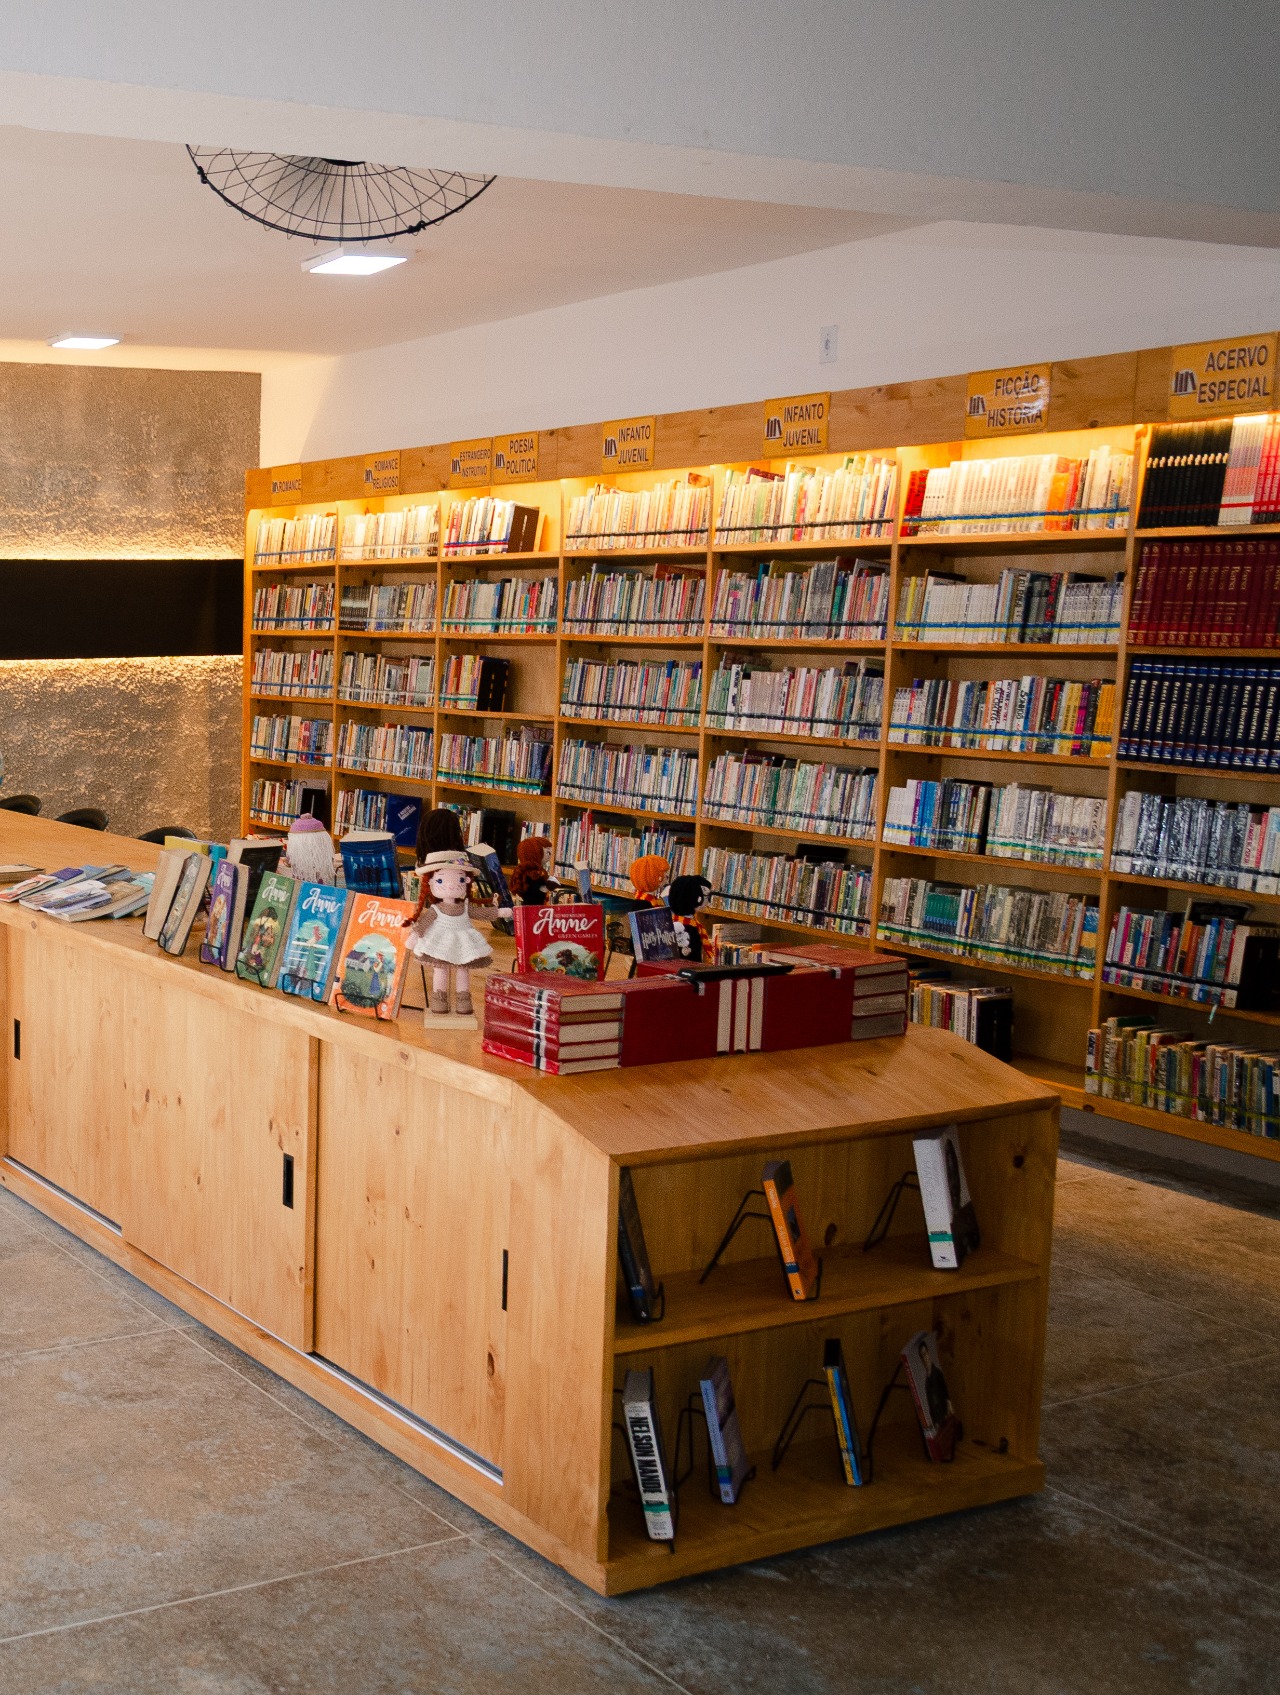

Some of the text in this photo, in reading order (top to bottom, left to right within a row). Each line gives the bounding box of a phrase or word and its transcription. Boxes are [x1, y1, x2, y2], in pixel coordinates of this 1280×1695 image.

[1204, 344, 1268, 373] ACERVO
[994, 371, 1040, 399] FICÇÃO
[1197, 376, 1270, 404] ESPECIAL
[783, 402, 824, 424] INFANTO
[618, 424, 651, 442] INFANTO
[783, 428, 822, 447] JUVENIL
[509, 438, 534, 454] POESIA
[617, 447, 649, 465] JUVENIL
[374, 458, 399, 472] ROMANCE
[279, 479, 302, 493] ROMANCE
[373, 476, 399, 489] RELIGIOSO
[262, 877, 291, 902] Anne
[302, 887, 342, 914] Anne
[358, 900, 407, 927] Anne
[533, 907, 598, 936] Anne
[629, 1416, 655, 1457] NELSON
[636, 1458, 662, 1494] MANDE
